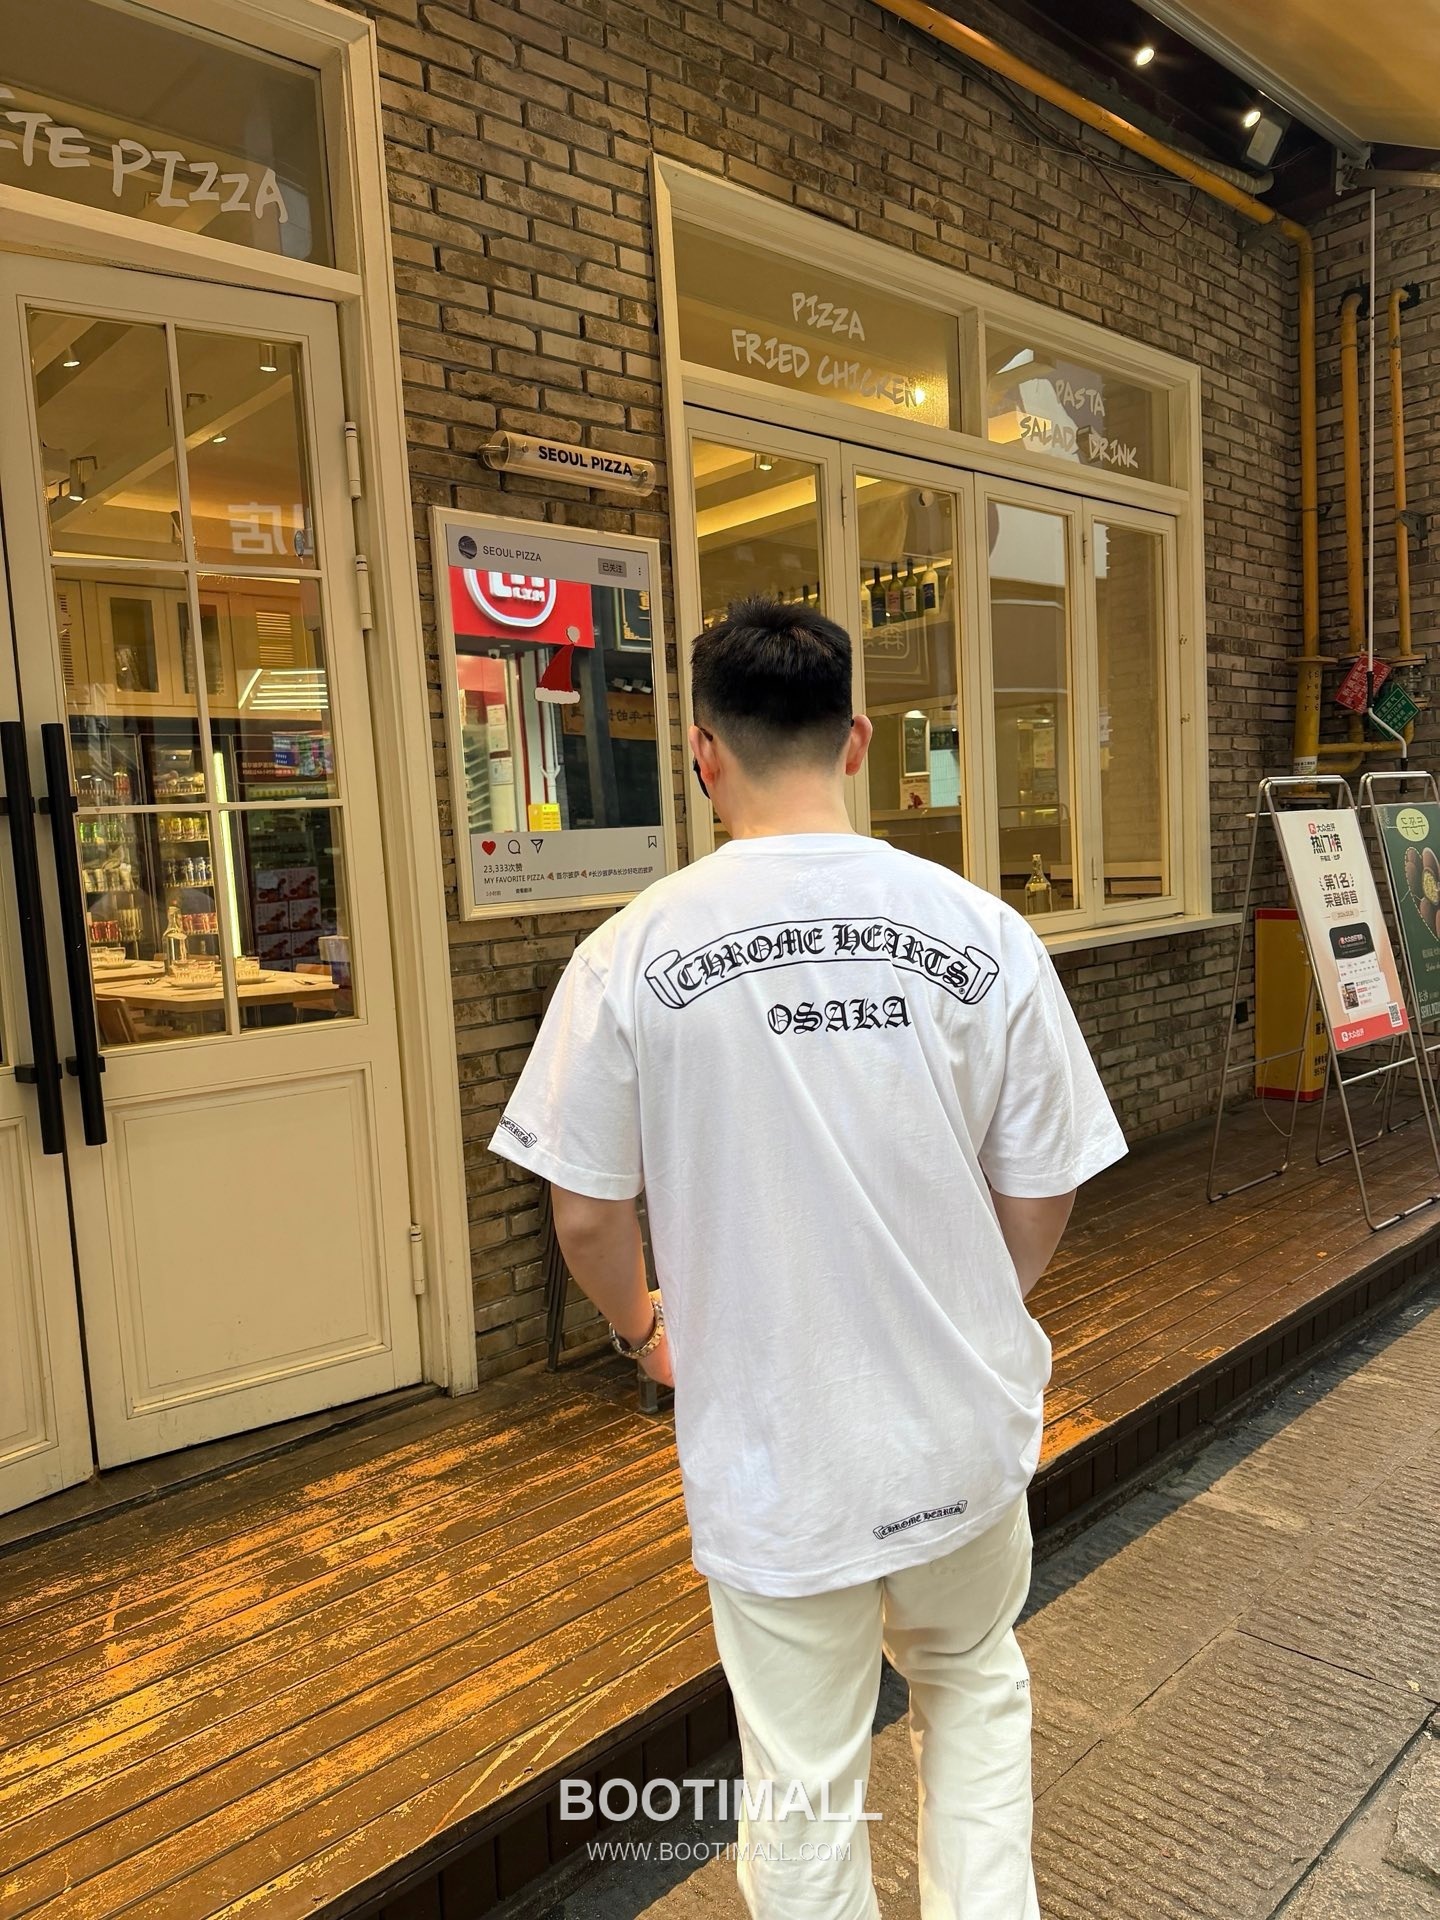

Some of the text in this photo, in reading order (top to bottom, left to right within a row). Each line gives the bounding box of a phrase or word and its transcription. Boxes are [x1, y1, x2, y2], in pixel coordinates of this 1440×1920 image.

[0, 88, 289, 224] TE PIZZA
[791, 291, 866, 342] PIZZA
[731, 328, 918, 408] FRIED CHICKEN
[1055, 379, 1106, 417] PASTA
[1019, 415, 1139, 469] SALAD DRINK
[538, 445, 634, 477] SEOUL PIZZA
[482, 545, 542, 563] SEOUL PIZZA
[601, 564, 624, 574] 已关注
[1310, 833, 1343, 854] 热门榜
[483, 863, 523, 874] 23,333次赞
[484, 876, 495, 885] MY
[495, 874, 526, 884] FAVORITE
[526, 873, 545, 883] PIZZA
[1323, 872, 1351, 891] 第1名
[1323, 890, 1359, 908] 荣登榜首
[676, 923, 971, 991] CHROME HEARTS
[766, 995, 912, 1035] OSAKA
